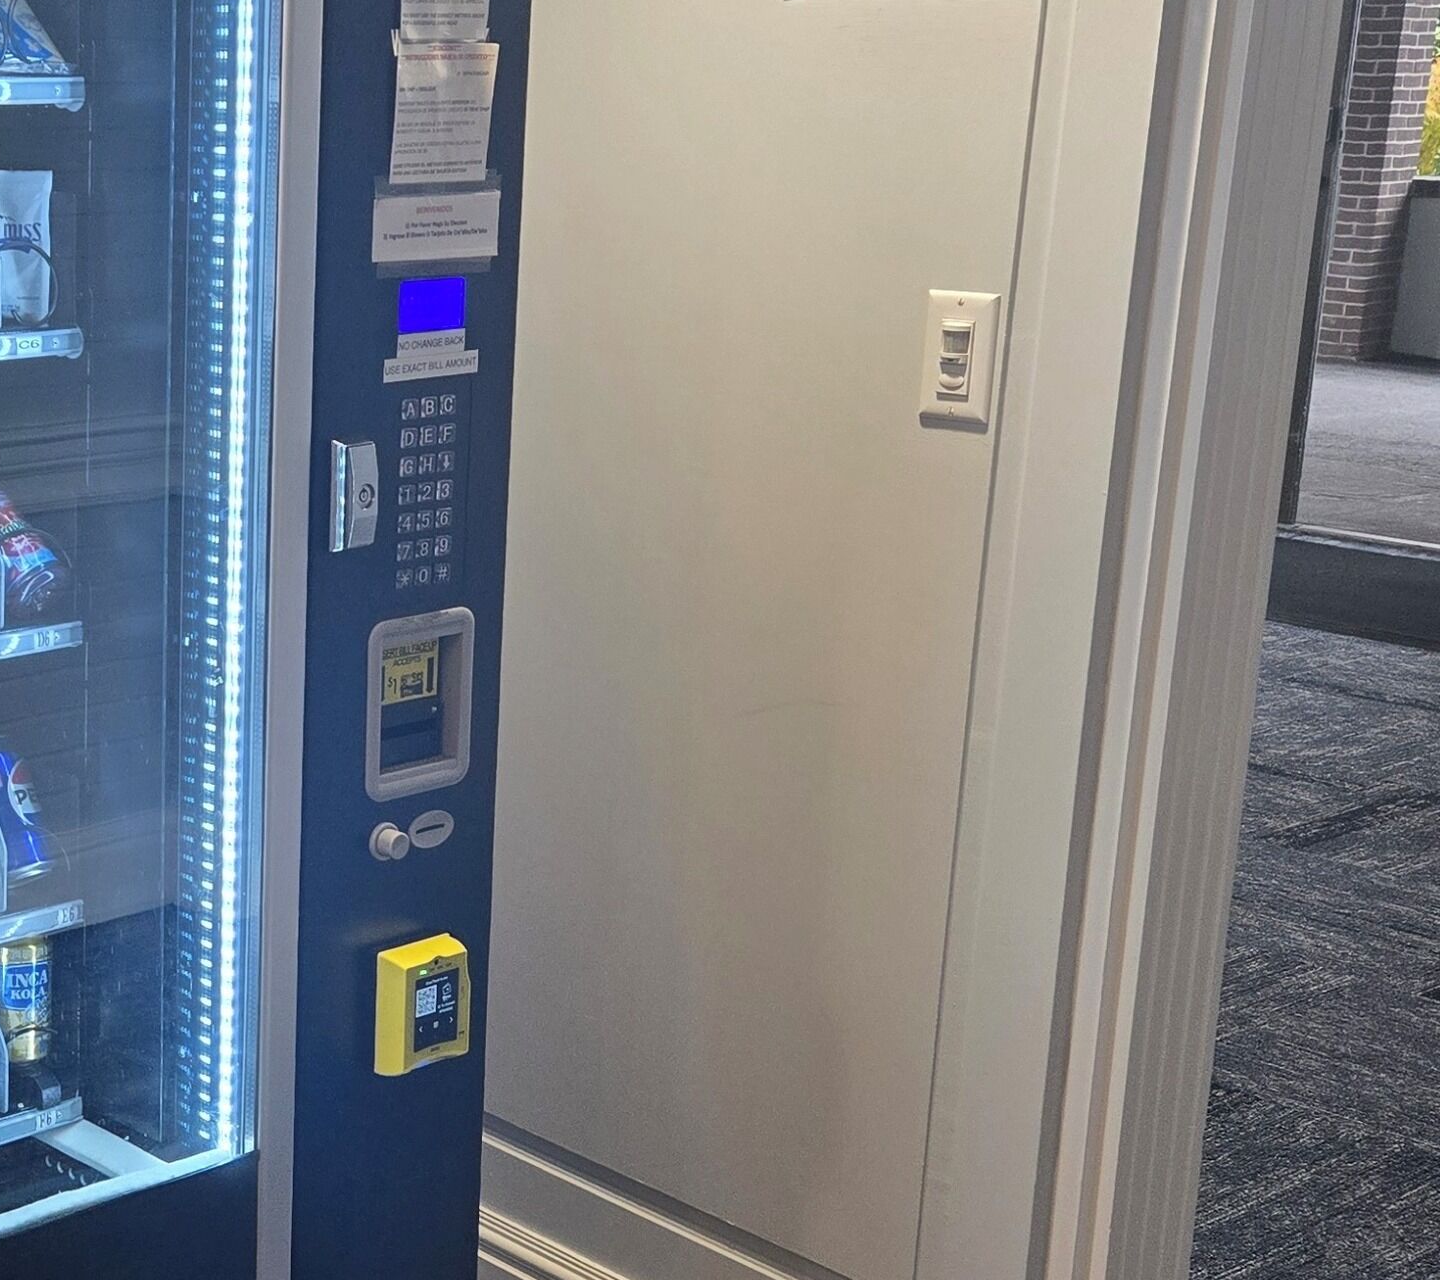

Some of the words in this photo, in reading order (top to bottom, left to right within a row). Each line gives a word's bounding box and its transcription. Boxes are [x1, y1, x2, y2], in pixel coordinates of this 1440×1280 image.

[18, 338, 40, 350] C6
[399, 341, 410, 352] NO
[411, 337, 442, 350] CHANGE
[444, 335, 464, 346] BACK
[385, 365, 401, 376] USE
[402, 362, 427, 374] EXACT
[428, 360, 444, 371] BILL
[444, 357, 476, 369] AMOUNT
[406, 404, 415, 415] A
[425, 401, 435, 413] B
[444, 399, 454, 411] C
[405, 432, 414, 443] D
[425, 429, 434, 441] E
[444, 427, 453, 439] F
[404, 461, 414, 473] G
[424, 458, 433, 471] H
[422, 486, 432, 499] 2
[441, 485, 450, 497] 3
[401, 518, 411, 530] 4
[421, 514, 430, 527] 5
[440, 512, 449, 525] 6
[402, 546, 410, 558] 7
[420, 543, 429, 556] 8
[439, 539, 448, 552] 9
[37, 631, 50, 647] D6
[61, 907, 75, 924] E6
[6, 969, 49, 988] INCA
[39, 1110, 52, 1126] F6
